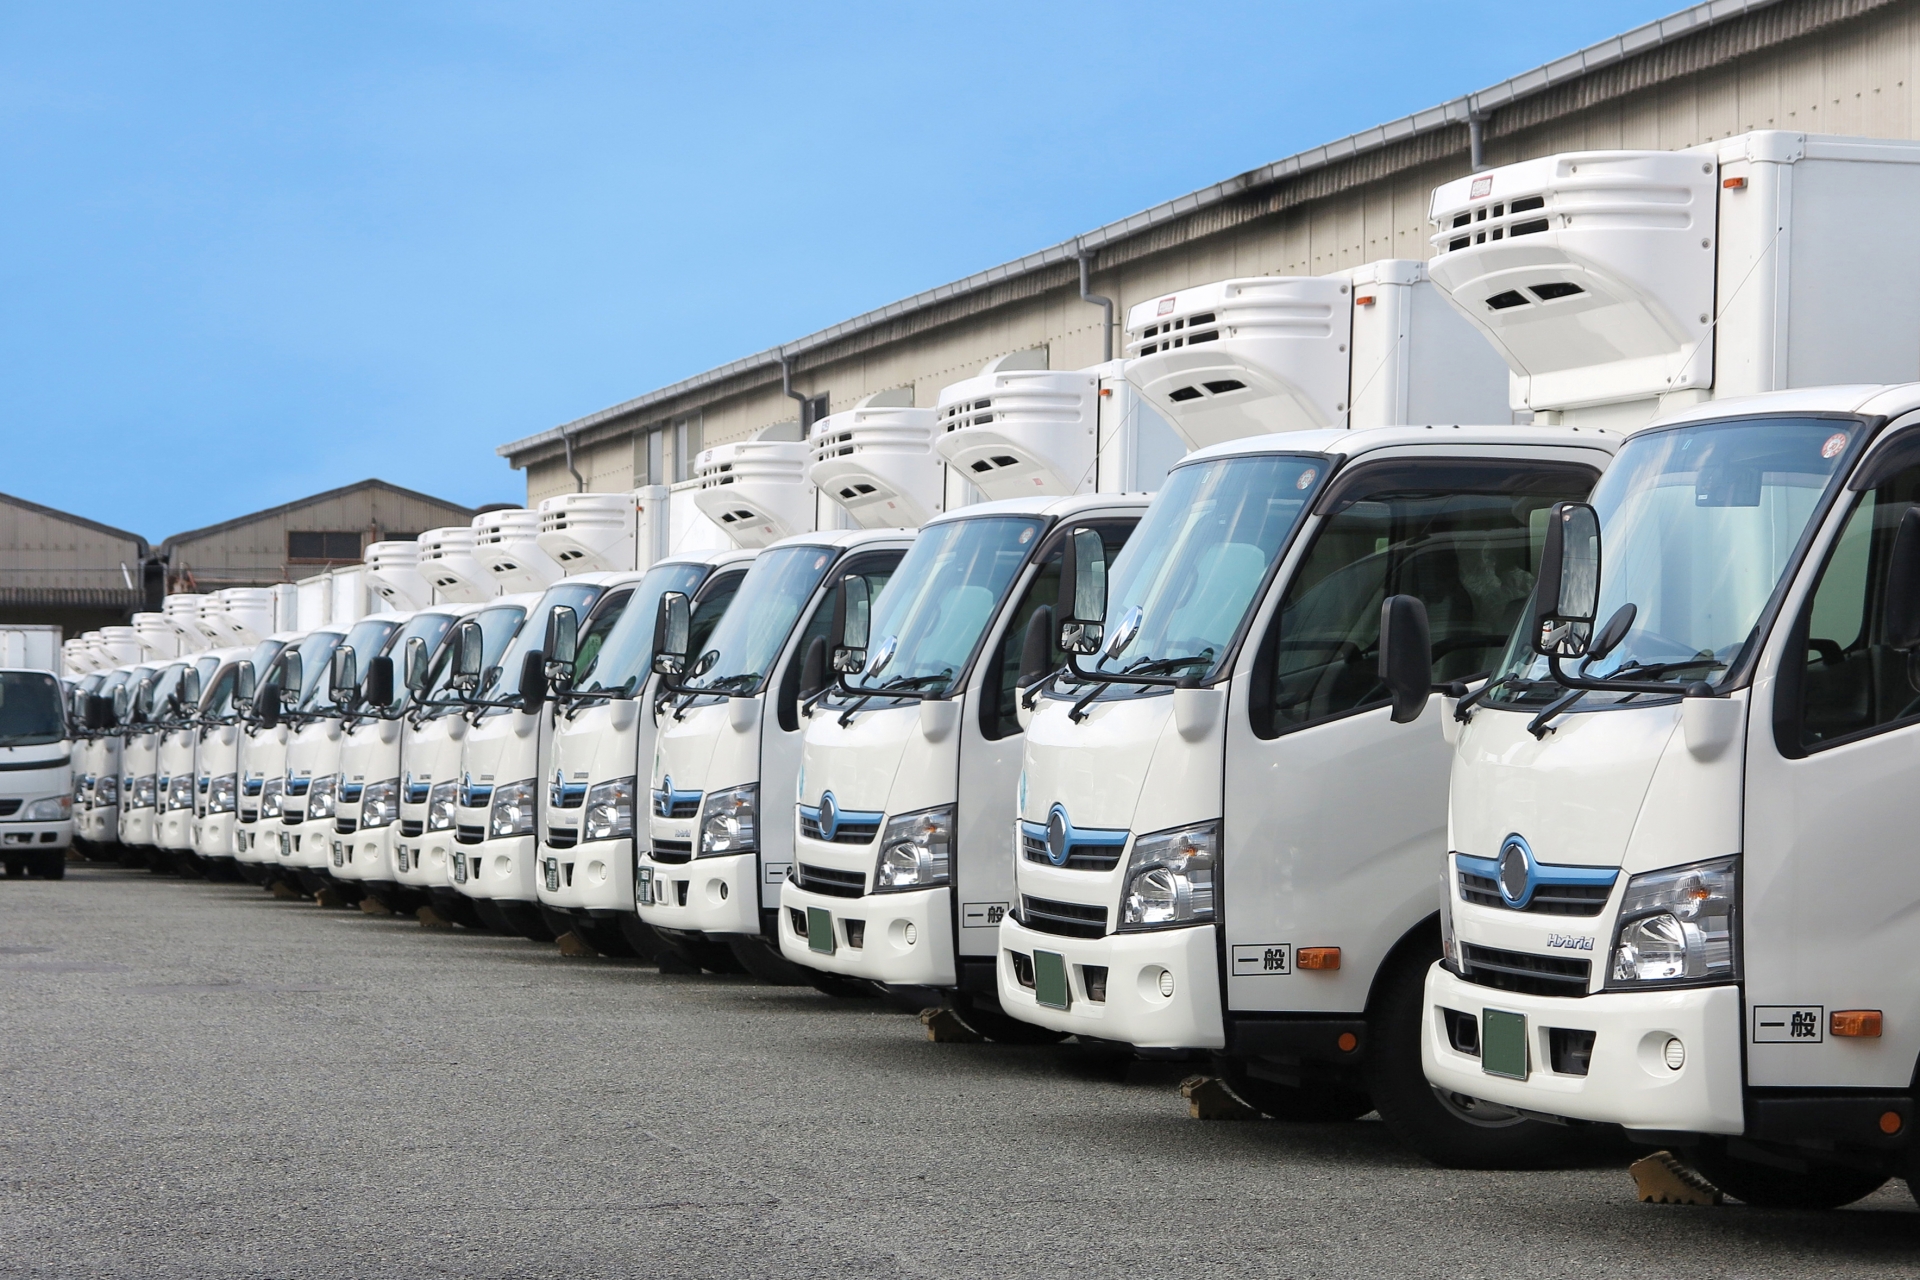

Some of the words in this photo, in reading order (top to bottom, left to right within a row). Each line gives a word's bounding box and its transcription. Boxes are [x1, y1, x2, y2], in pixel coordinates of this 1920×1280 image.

[967, 905, 1004, 923] 一般
[1547, 933, 1595, 951] Hybrid
[1238, 948, 1285, 971] 一般
[1760, 1011, 1816, 1038] 一般
